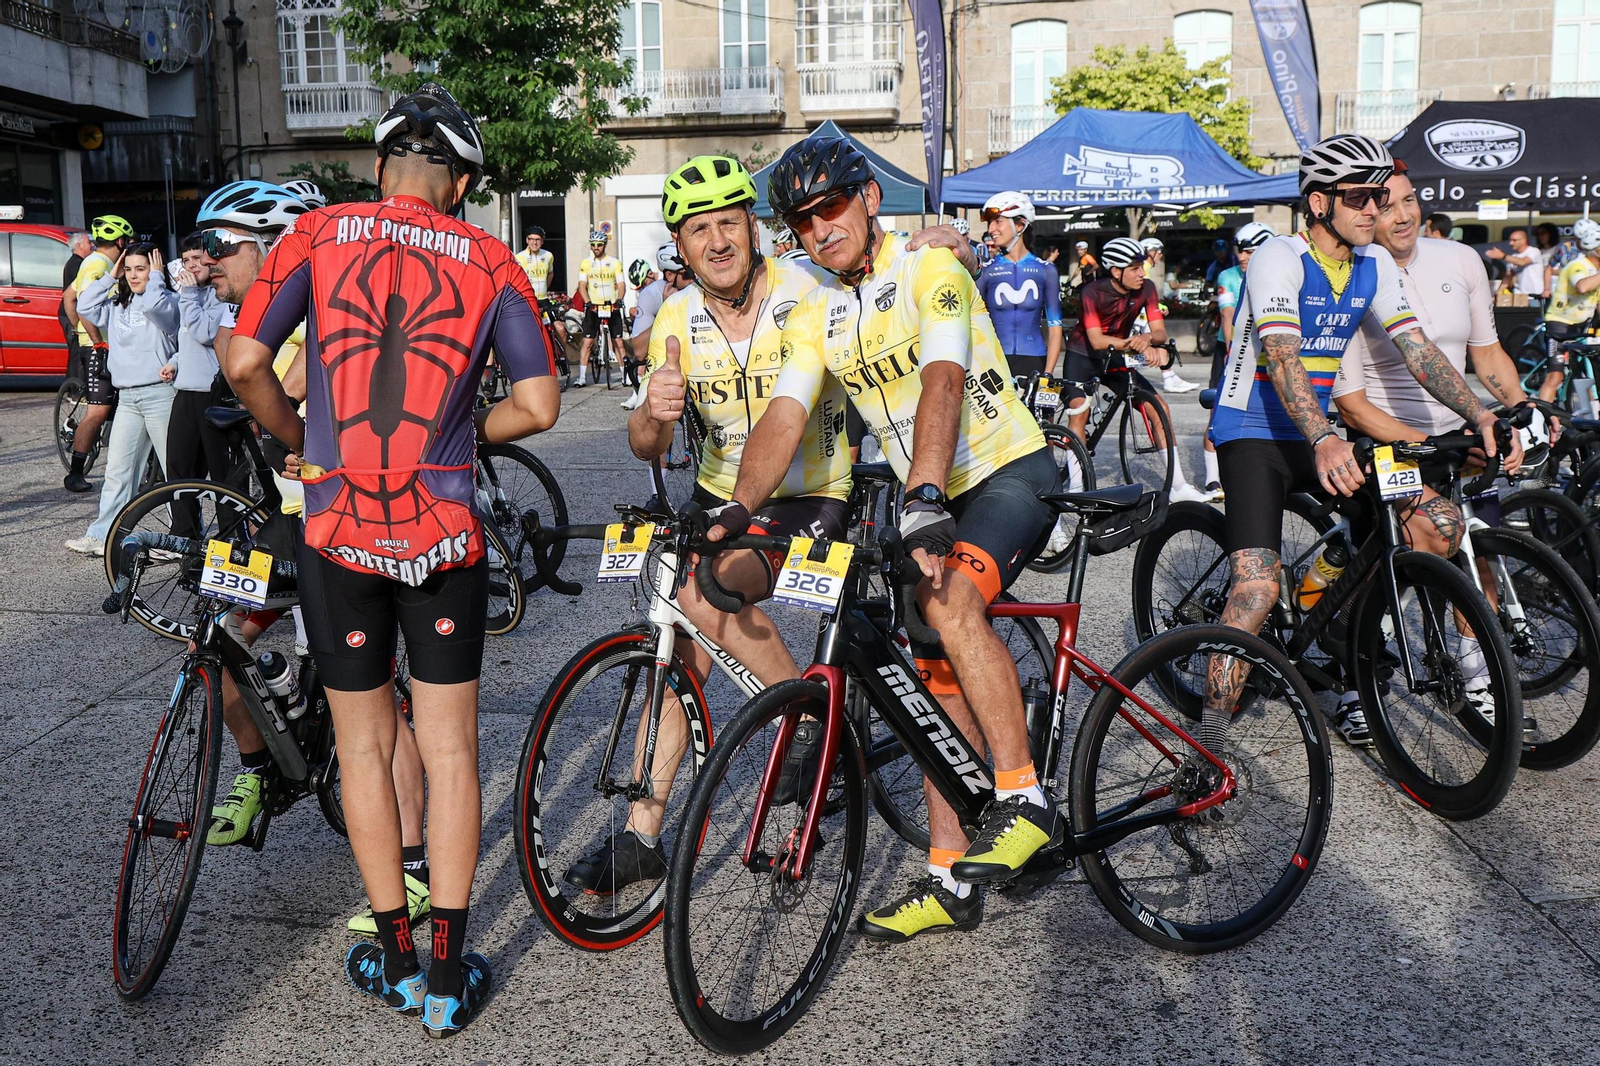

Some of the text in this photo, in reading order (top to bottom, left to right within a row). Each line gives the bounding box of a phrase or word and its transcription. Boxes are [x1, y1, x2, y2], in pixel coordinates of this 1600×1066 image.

[0, 113, 35, 134] CaixaBank
[1439, 140, 1519, 154] ÁlvaroPino
[1021, 184, 1230, 202] FERRETERIA BARRAL
[1412, 178, 1465, 200] elo
[336, 215, 470, 266] ADC PICARAÑA
[1270, 296, 1291, 304] CAFE
[1262, 306, 1299, 317] COLOMBIA
[1315, 313, 1351, 327] CAFE
[1320, 326, 1335, 335] DE
[1227, 372, 1241, 398] CAFE
[1239, 314, 1254, 358] COLOMBIA
[688, 371, 779, 406] SESTE
[1038, 392, 1057, 402] 500
[823, 399, 836, 458] LUSTAND
[1387, 471, 1416, 486] 423
[654, 525, 667, 535] 3T
[375, 538, 410, 549] AMURA
[606, 553, 638, 570] 327
[805, 561, 840, 576] ÁlvaroPino
[211, 570, 257, 593] 330
[785, 571, 832, 594] 326
[1197, 641, 1319, 746] FULCRUM
[1138, 909, 1155, 929] 400
[392, 916, 414, 954] R2
[433, 918, 449, 960] R2
[762, 868, 853, 1031] FULCRUM
